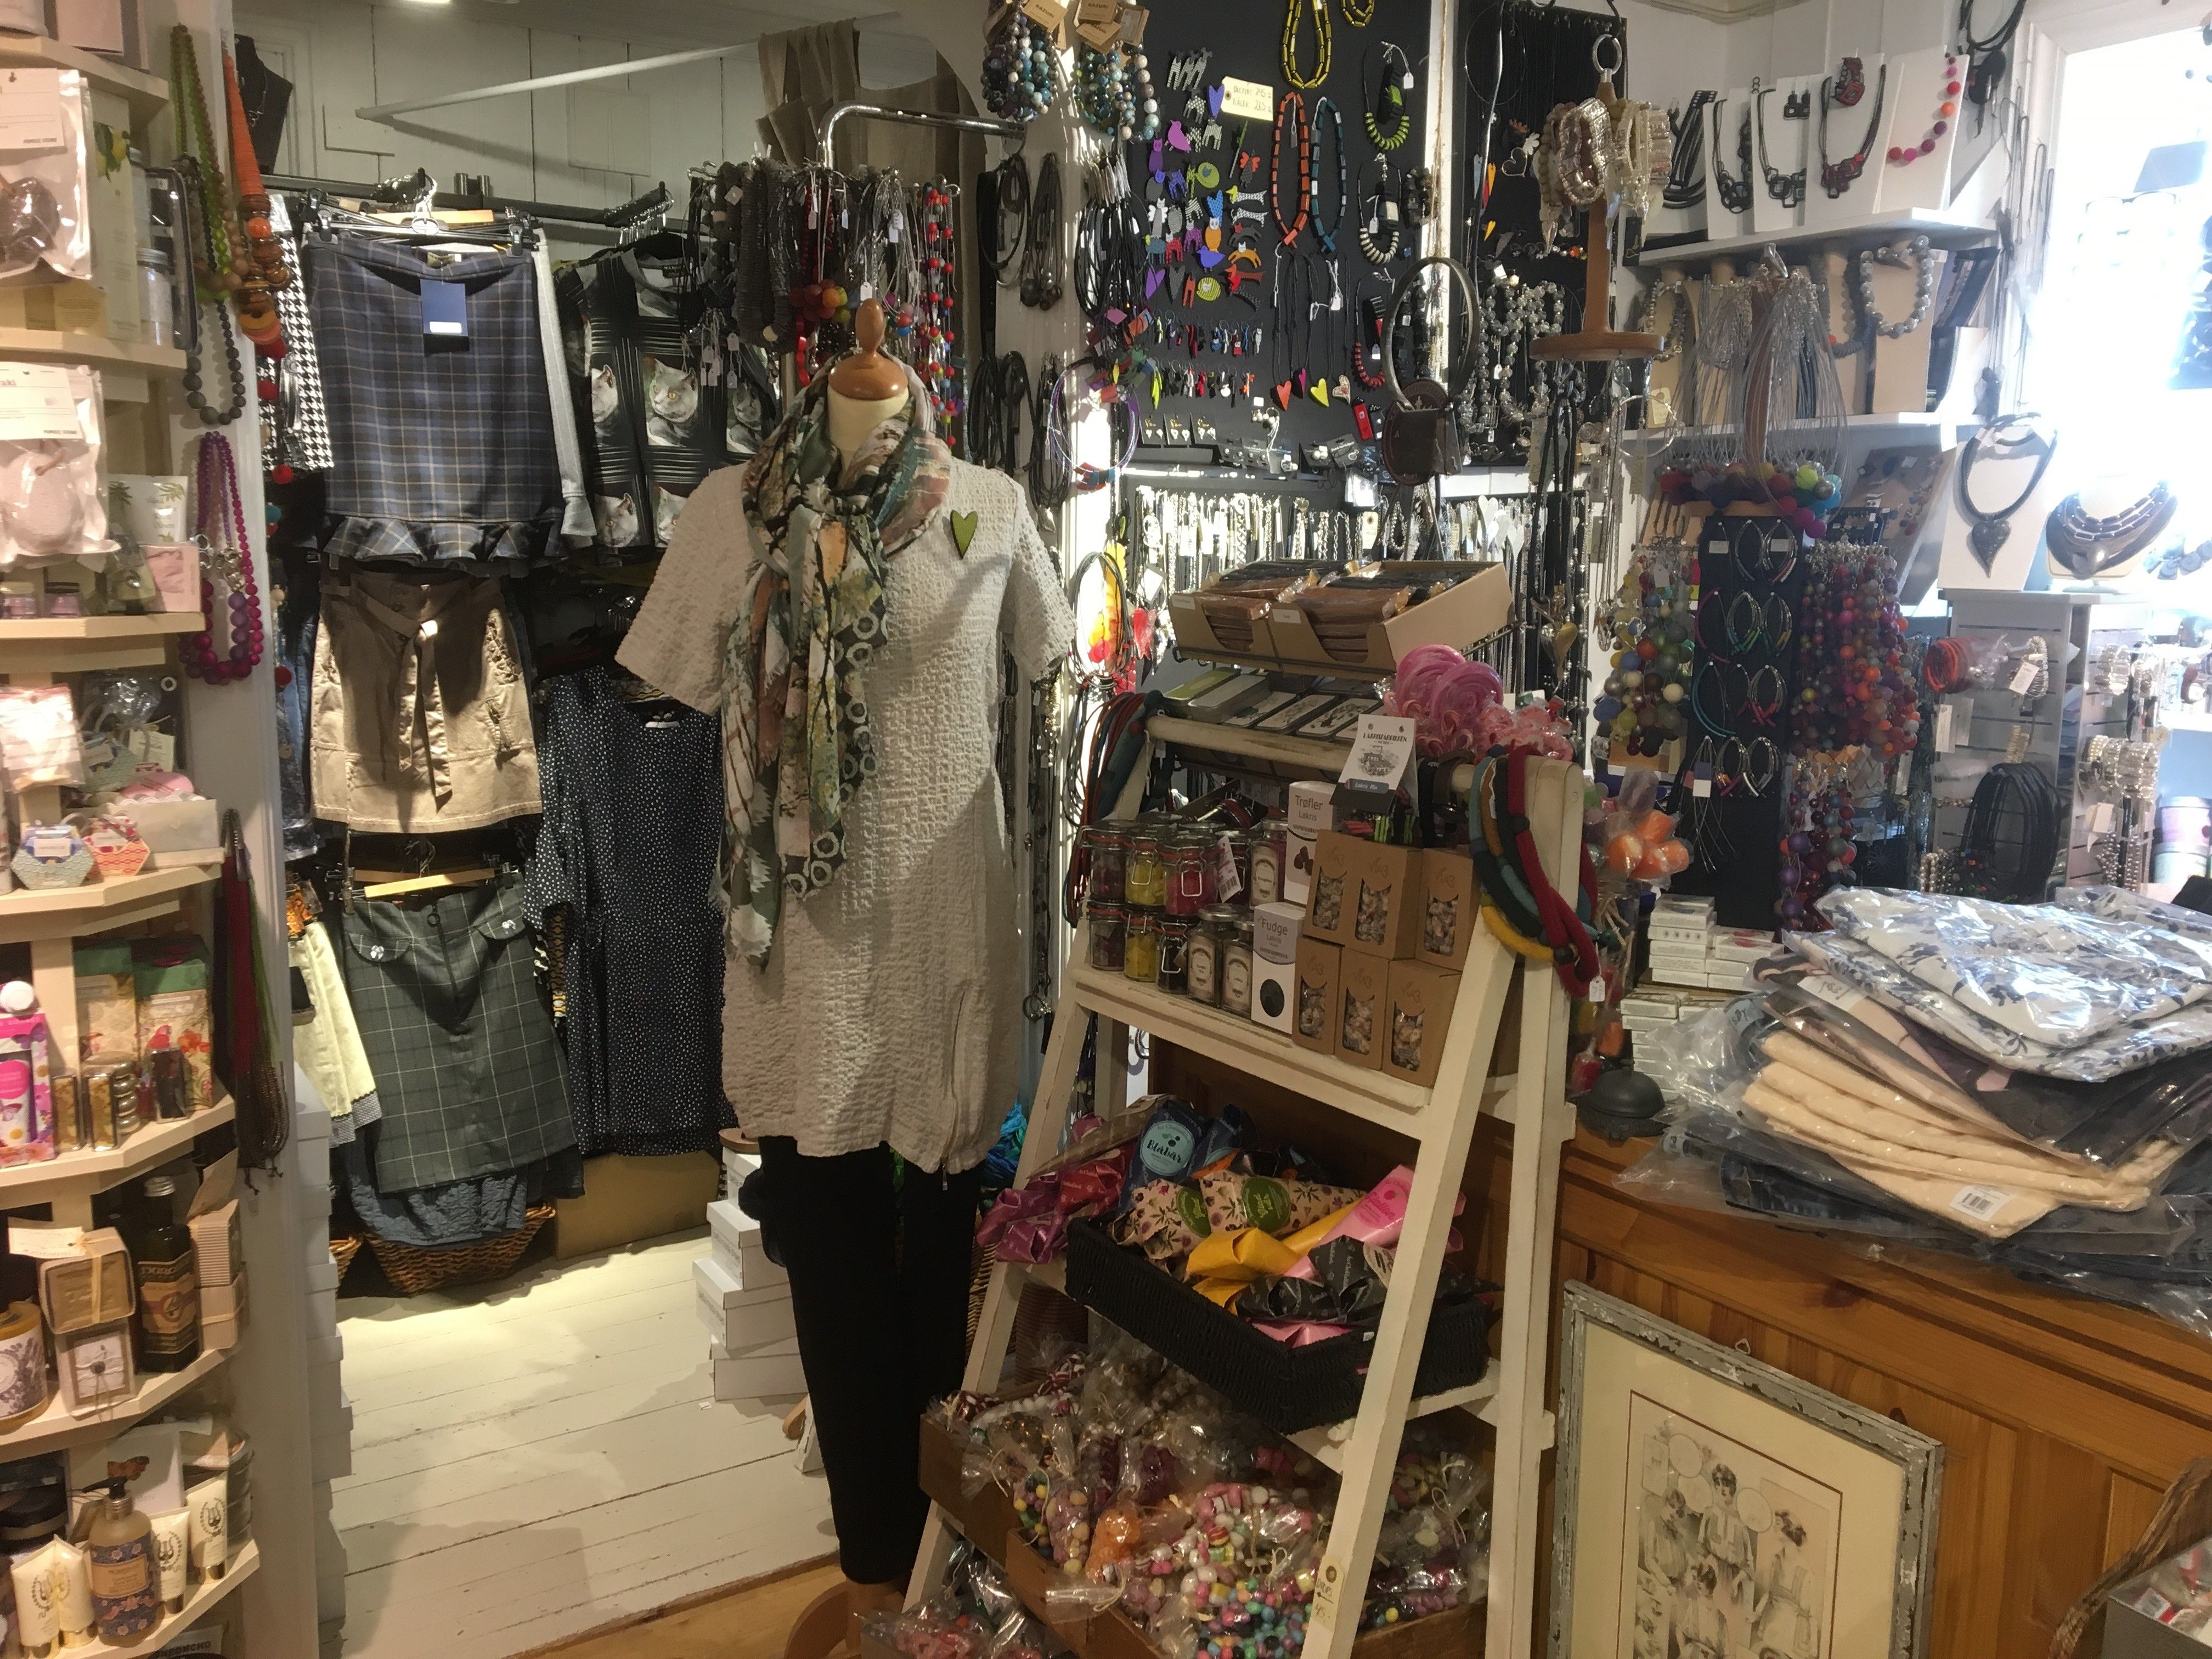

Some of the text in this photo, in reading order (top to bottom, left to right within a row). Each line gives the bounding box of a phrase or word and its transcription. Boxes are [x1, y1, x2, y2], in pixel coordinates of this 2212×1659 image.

[1035, 3, 1054, 18] KAZURI
[1363, 732, 1408, 742] LAKRISFABRIKKEN
[1295, 795, 1323, 811] Trøfler
[1299, 810, 1317, 821] Lakris
[1261, 918, 1288, 936] Fudge
[1266, 934, 1282, 944] Lakris
[1146, 1139, 1182, 1163] Blåbär
